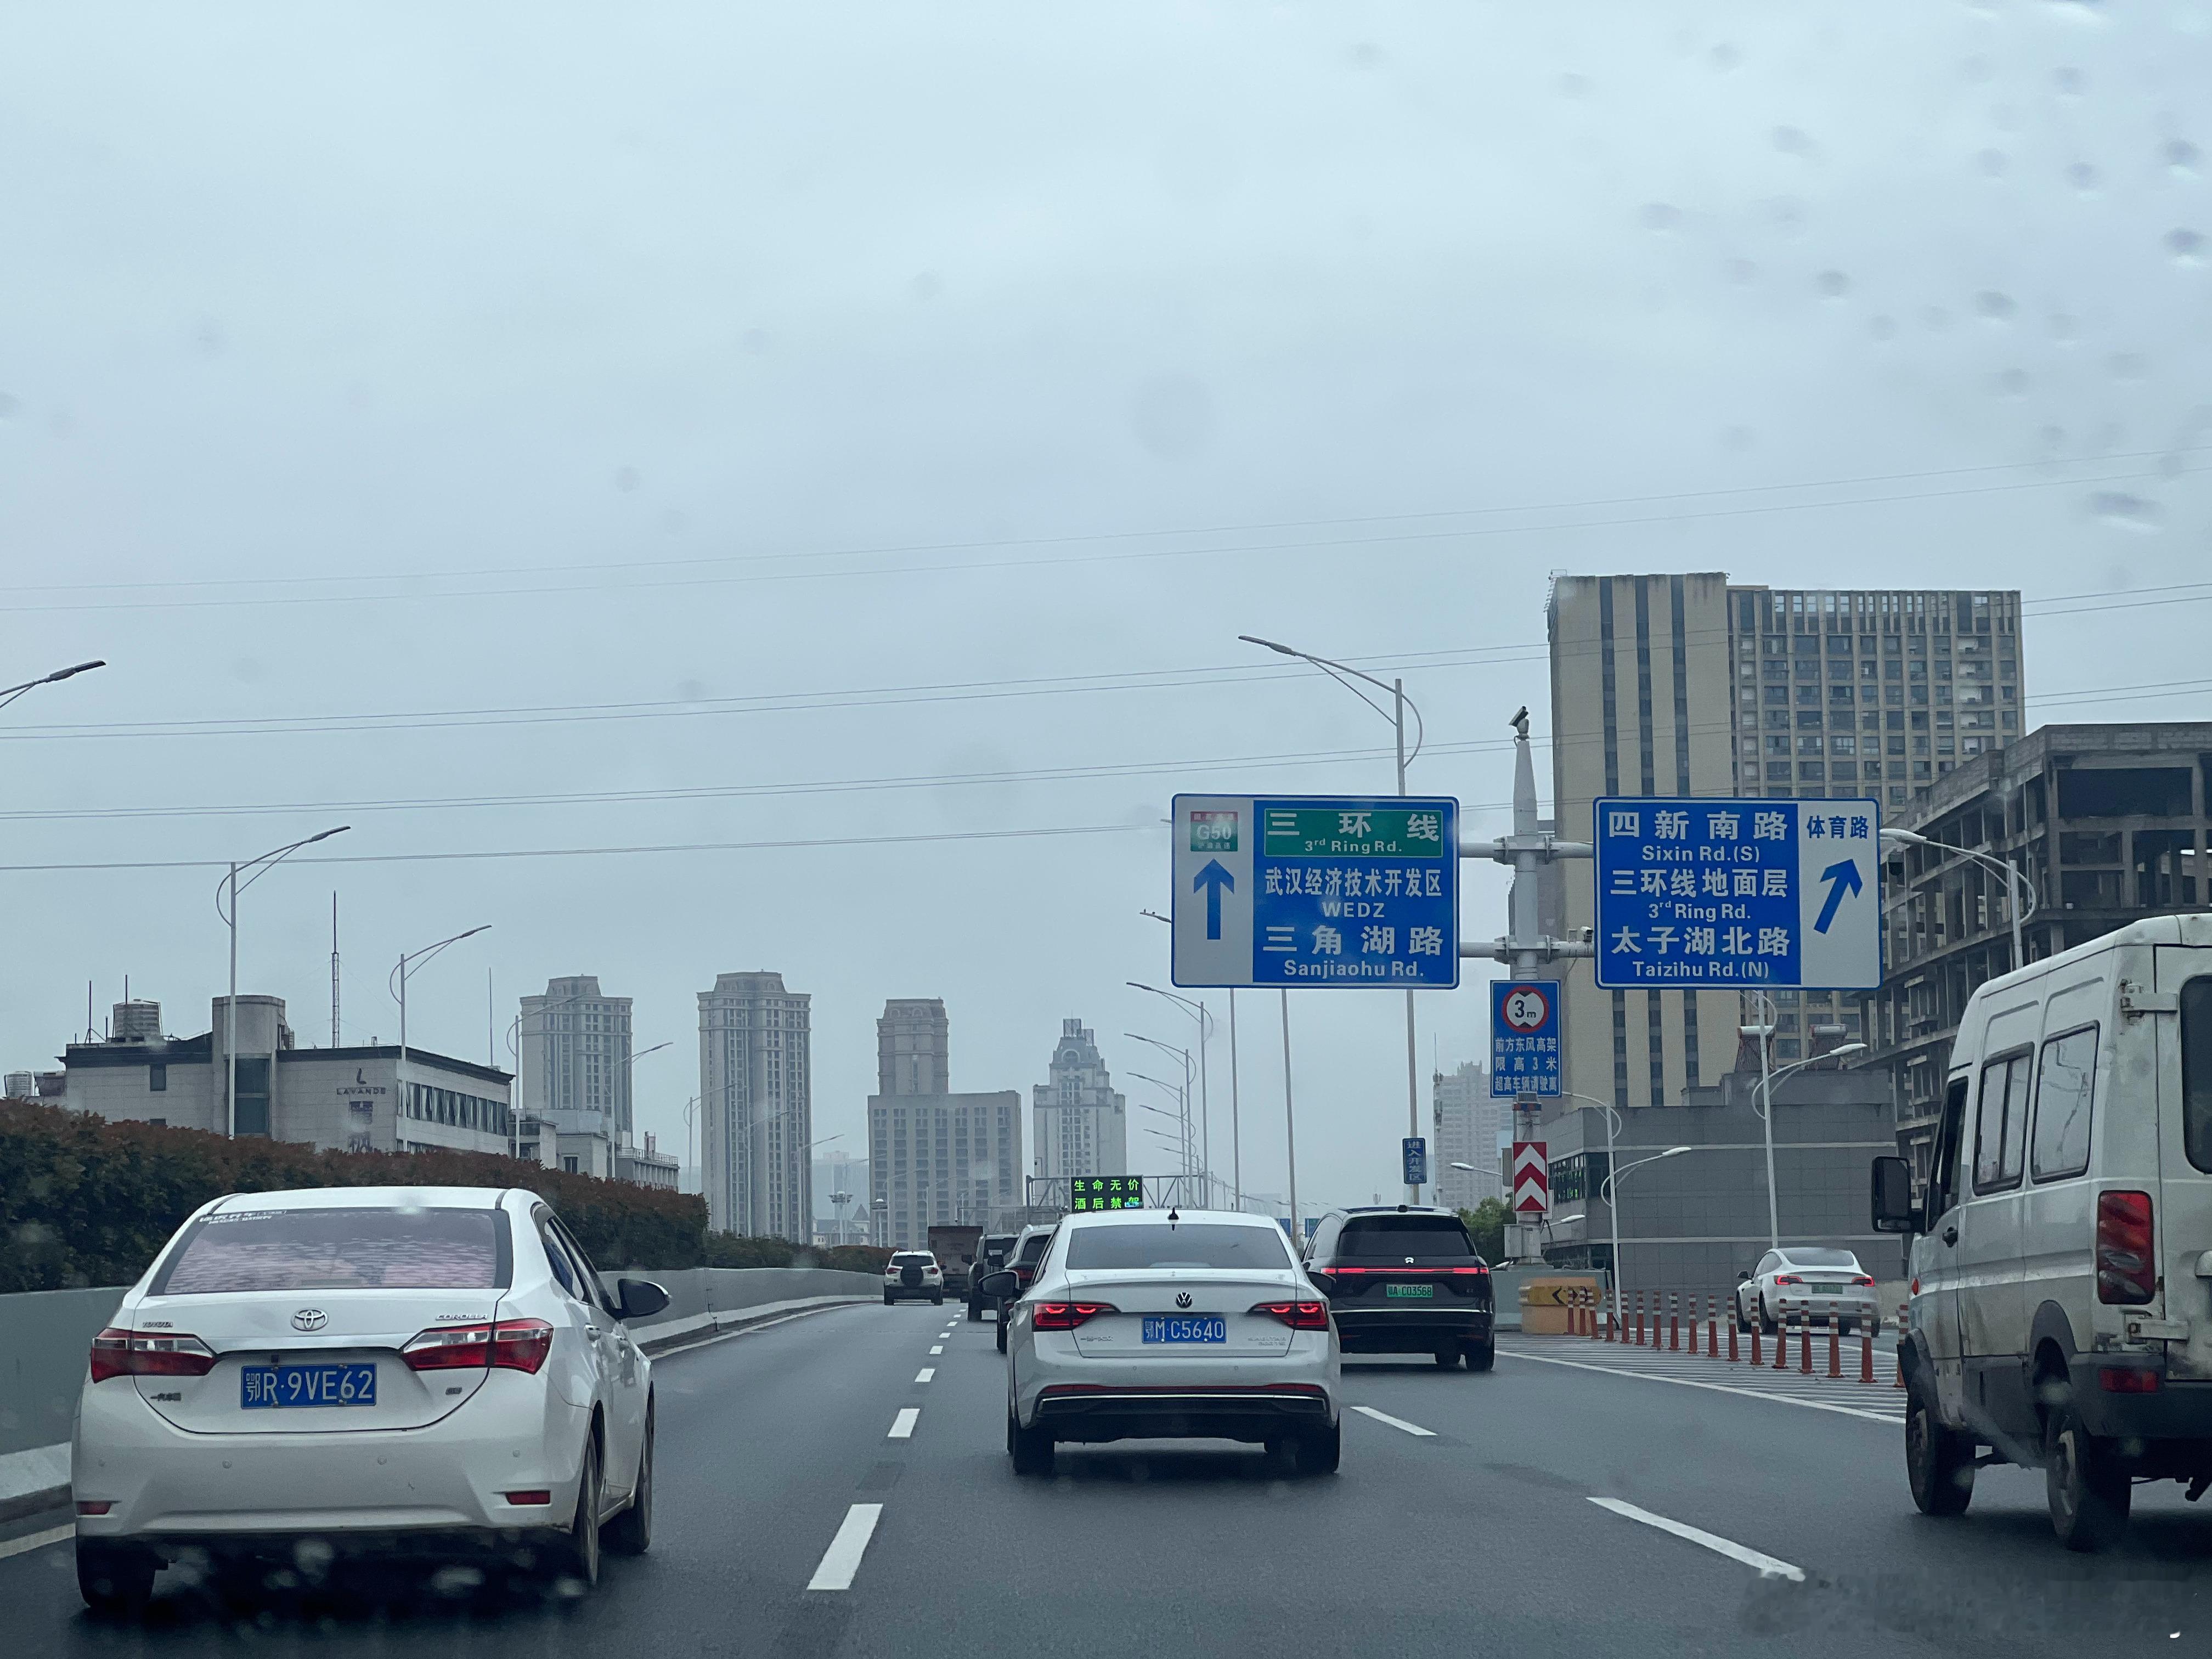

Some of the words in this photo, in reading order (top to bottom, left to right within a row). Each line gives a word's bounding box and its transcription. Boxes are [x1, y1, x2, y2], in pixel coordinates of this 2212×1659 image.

[1197, 824, 1232, 840] G50
[1267, 812, 1440, 842] 三环线
[1609, 810, 1788, 841] 四新南路
[1807, 815, 1869, 839] 体育路
[1305, 838, 1326, 853] 3rd
[1331, 840, 1370, 855] Ring
[1375, 840, 1402, 853] Rd.
[1641, 845, 1693, 861] Sixin
[1265, 867, 1442, 898] 武汉经济技术开发区
[1610, 868, 1788, 898] 三环线地面层
[1322, 901, 1385, 918] WEDZ
[1648, 900, 1672, 919] 3rd
[1675, 904, 1717, 922] Ring
[1722, 904, 1751, 919] Rd.
[1262, 924, 1444, 956] 三角湖路
[1611, 926, 1790, 957] 太子湖北路
[1284, 959, 1386, 979] Sanjiaohu
[1391, 960, 1424, 977] Rd.
[1632, 961, 1703, 978] Taizihu
[1496, 1036, 1557, 1053] 前方东风高架
[1074, 1178, 1139, 1192] 生命无价
